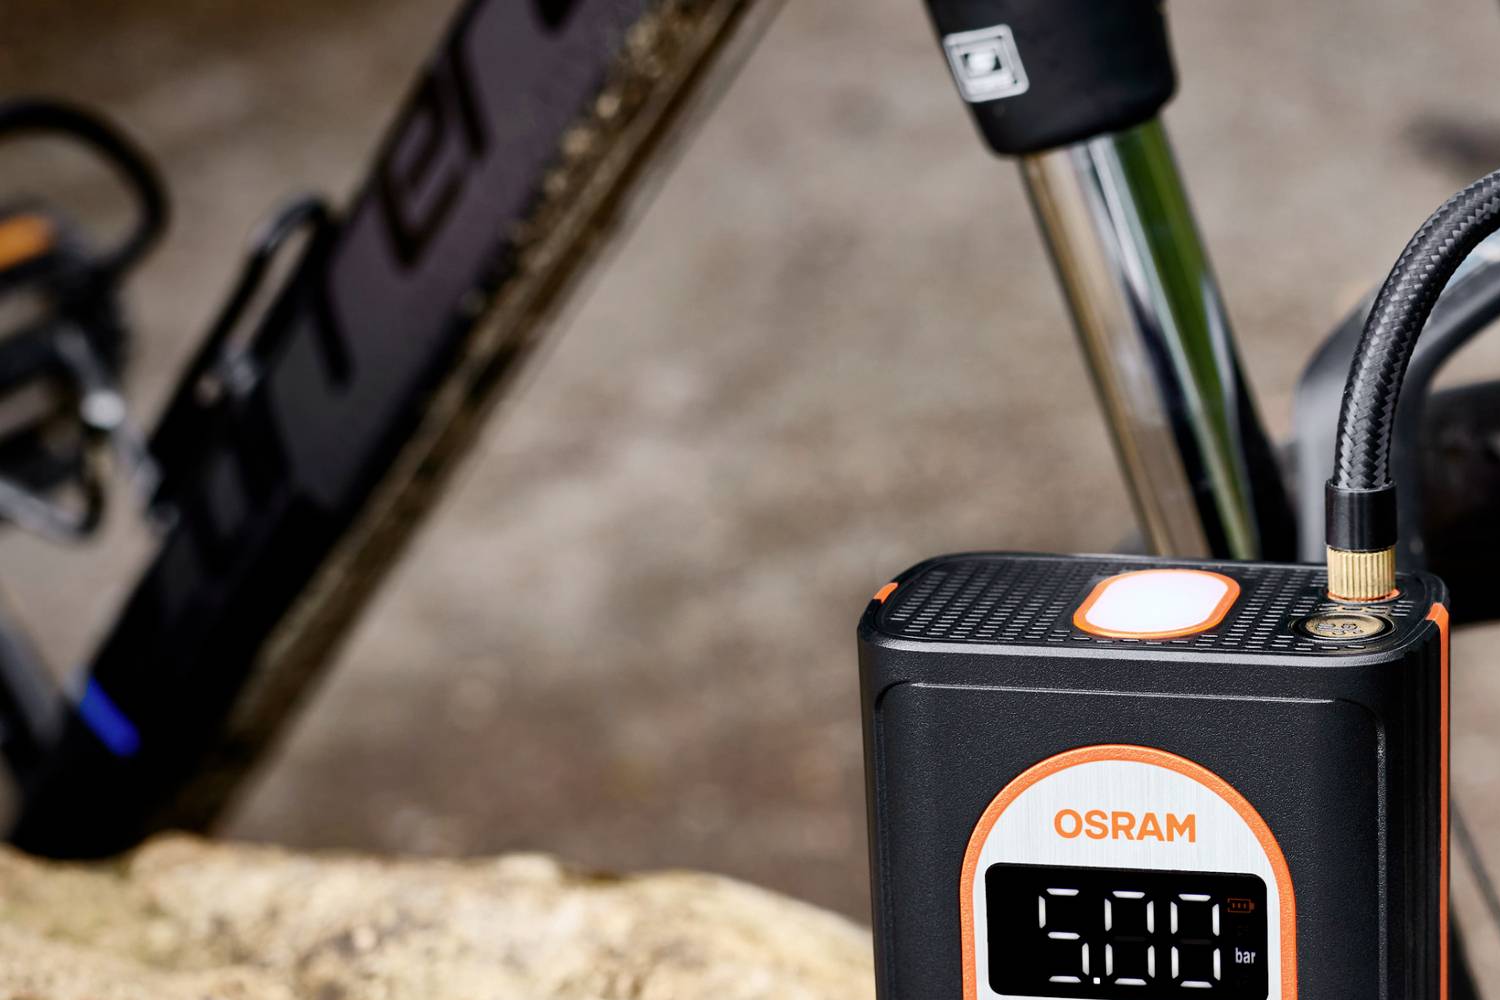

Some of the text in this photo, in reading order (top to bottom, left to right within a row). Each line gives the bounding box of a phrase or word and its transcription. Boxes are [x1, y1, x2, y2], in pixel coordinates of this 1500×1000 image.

[1054, 808, 1196, 842] OSRAM
[1038, 888, 1256, 988] 5.00 bar
